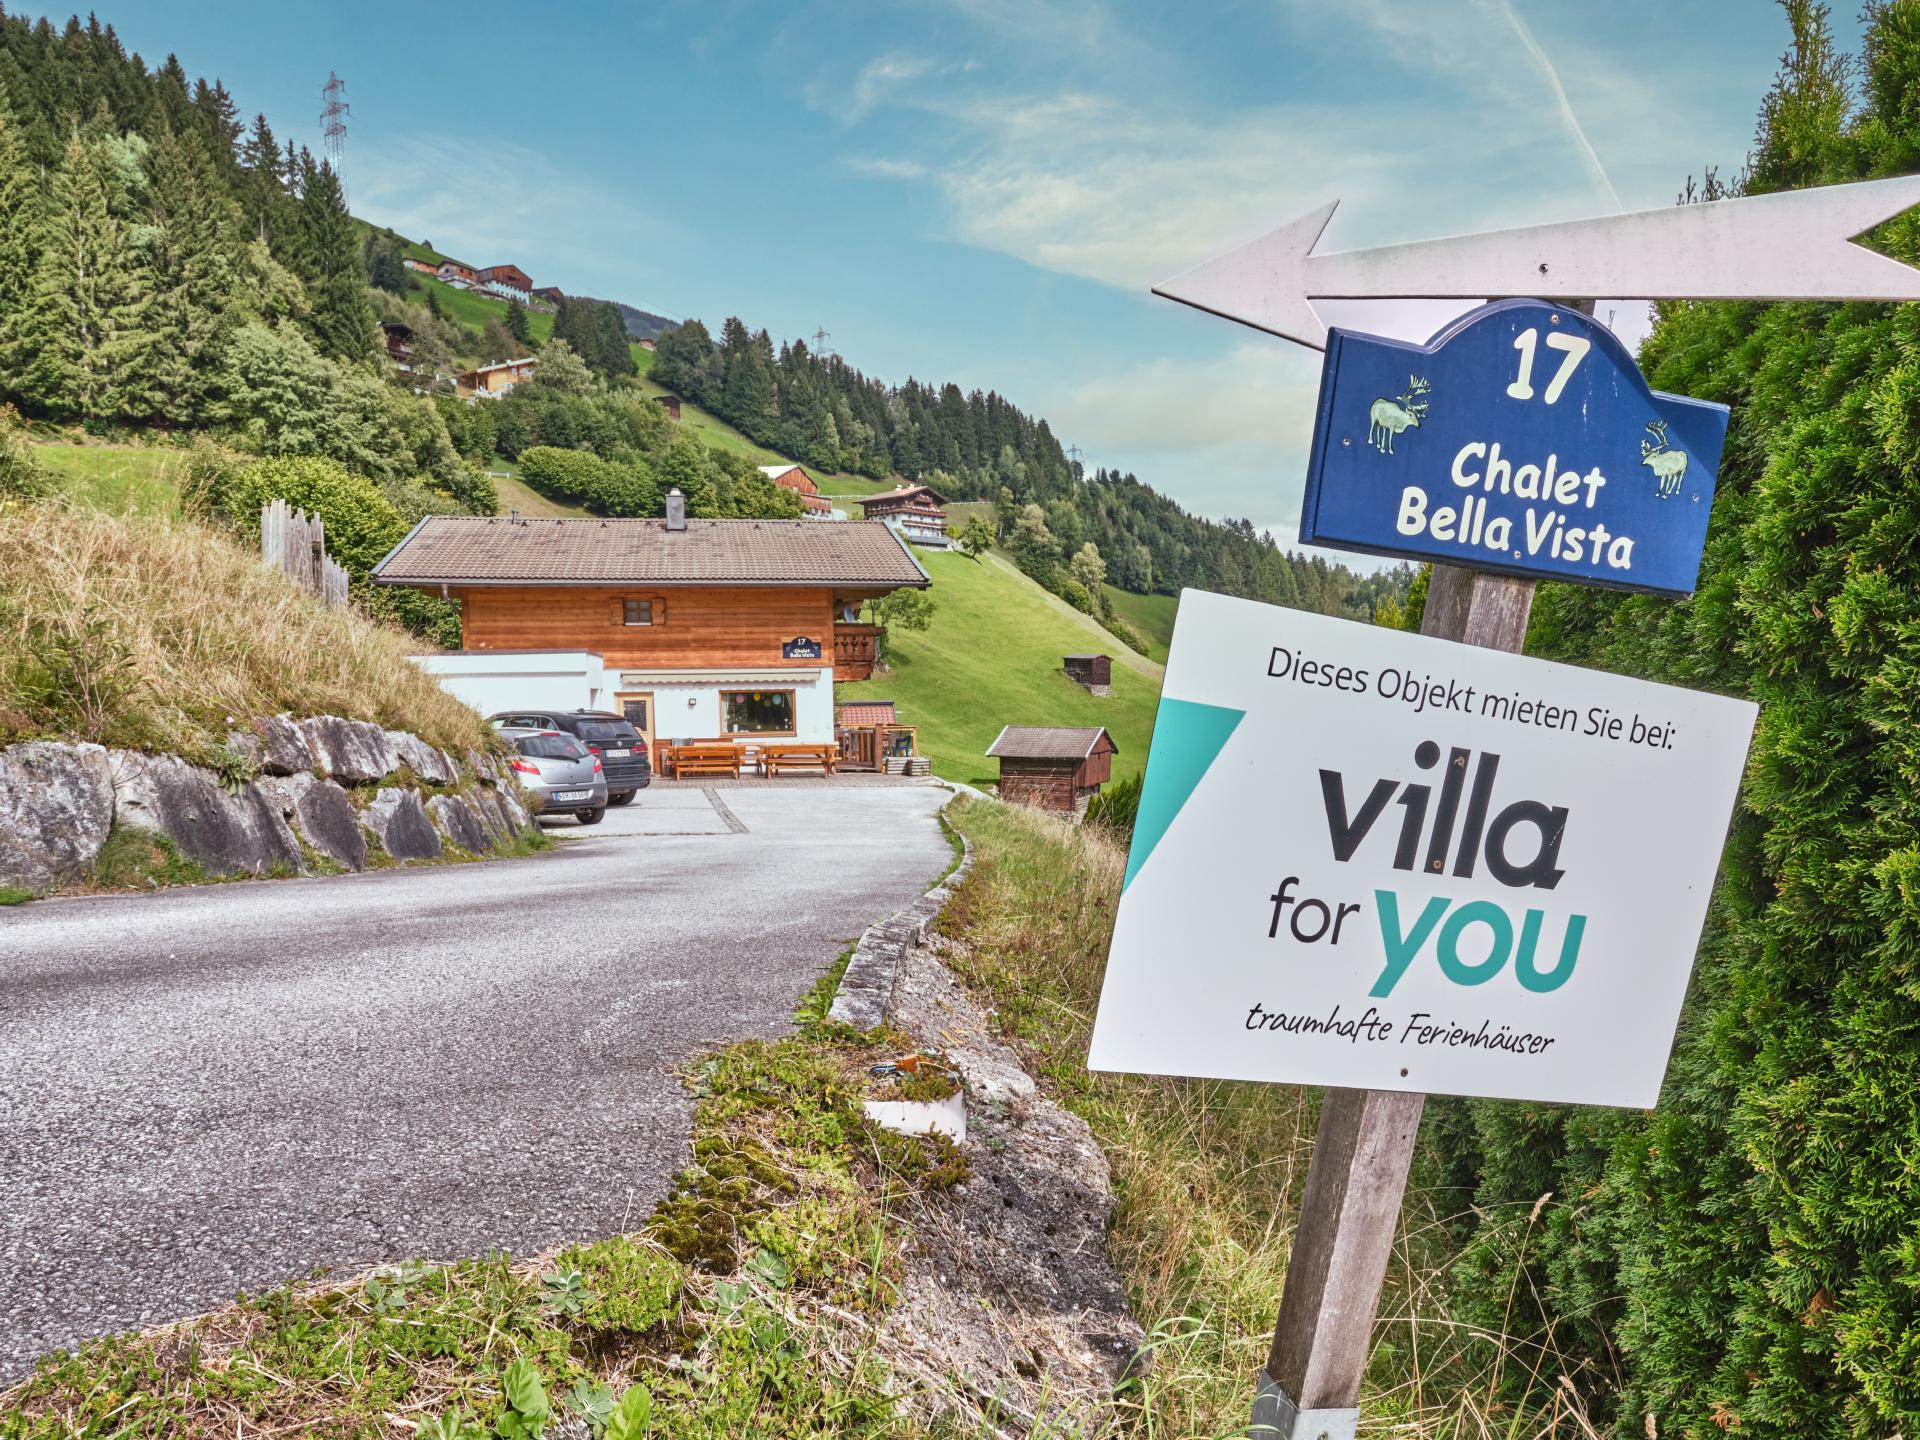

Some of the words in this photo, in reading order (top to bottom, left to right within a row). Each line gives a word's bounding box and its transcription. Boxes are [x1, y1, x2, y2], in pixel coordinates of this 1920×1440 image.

[1507, 329, 1590, 404] 17
[1452, 442, 1606, 508] Chalet
[1397, 486, 1512, 551] Bella
[1525, 508, 1635, 569] Vista
[1266, 647, 1368, 693] Dieses
[1377, 668, 1475, 714] Objekt
[1481, 693, 1578, 732] mieten
[1583, 706, 1624, 738] Sie
[1629, 720, 1677, 750] bei:
[1318, 740, 1569, 889] villa
[1268, 876, 1361, 945] for
[1367, 890, 1587, 998] you
[1245, 1002, 1393, 1043] traumhafte
[1400, 1011, 1555, 1055] Ferienhäuser
